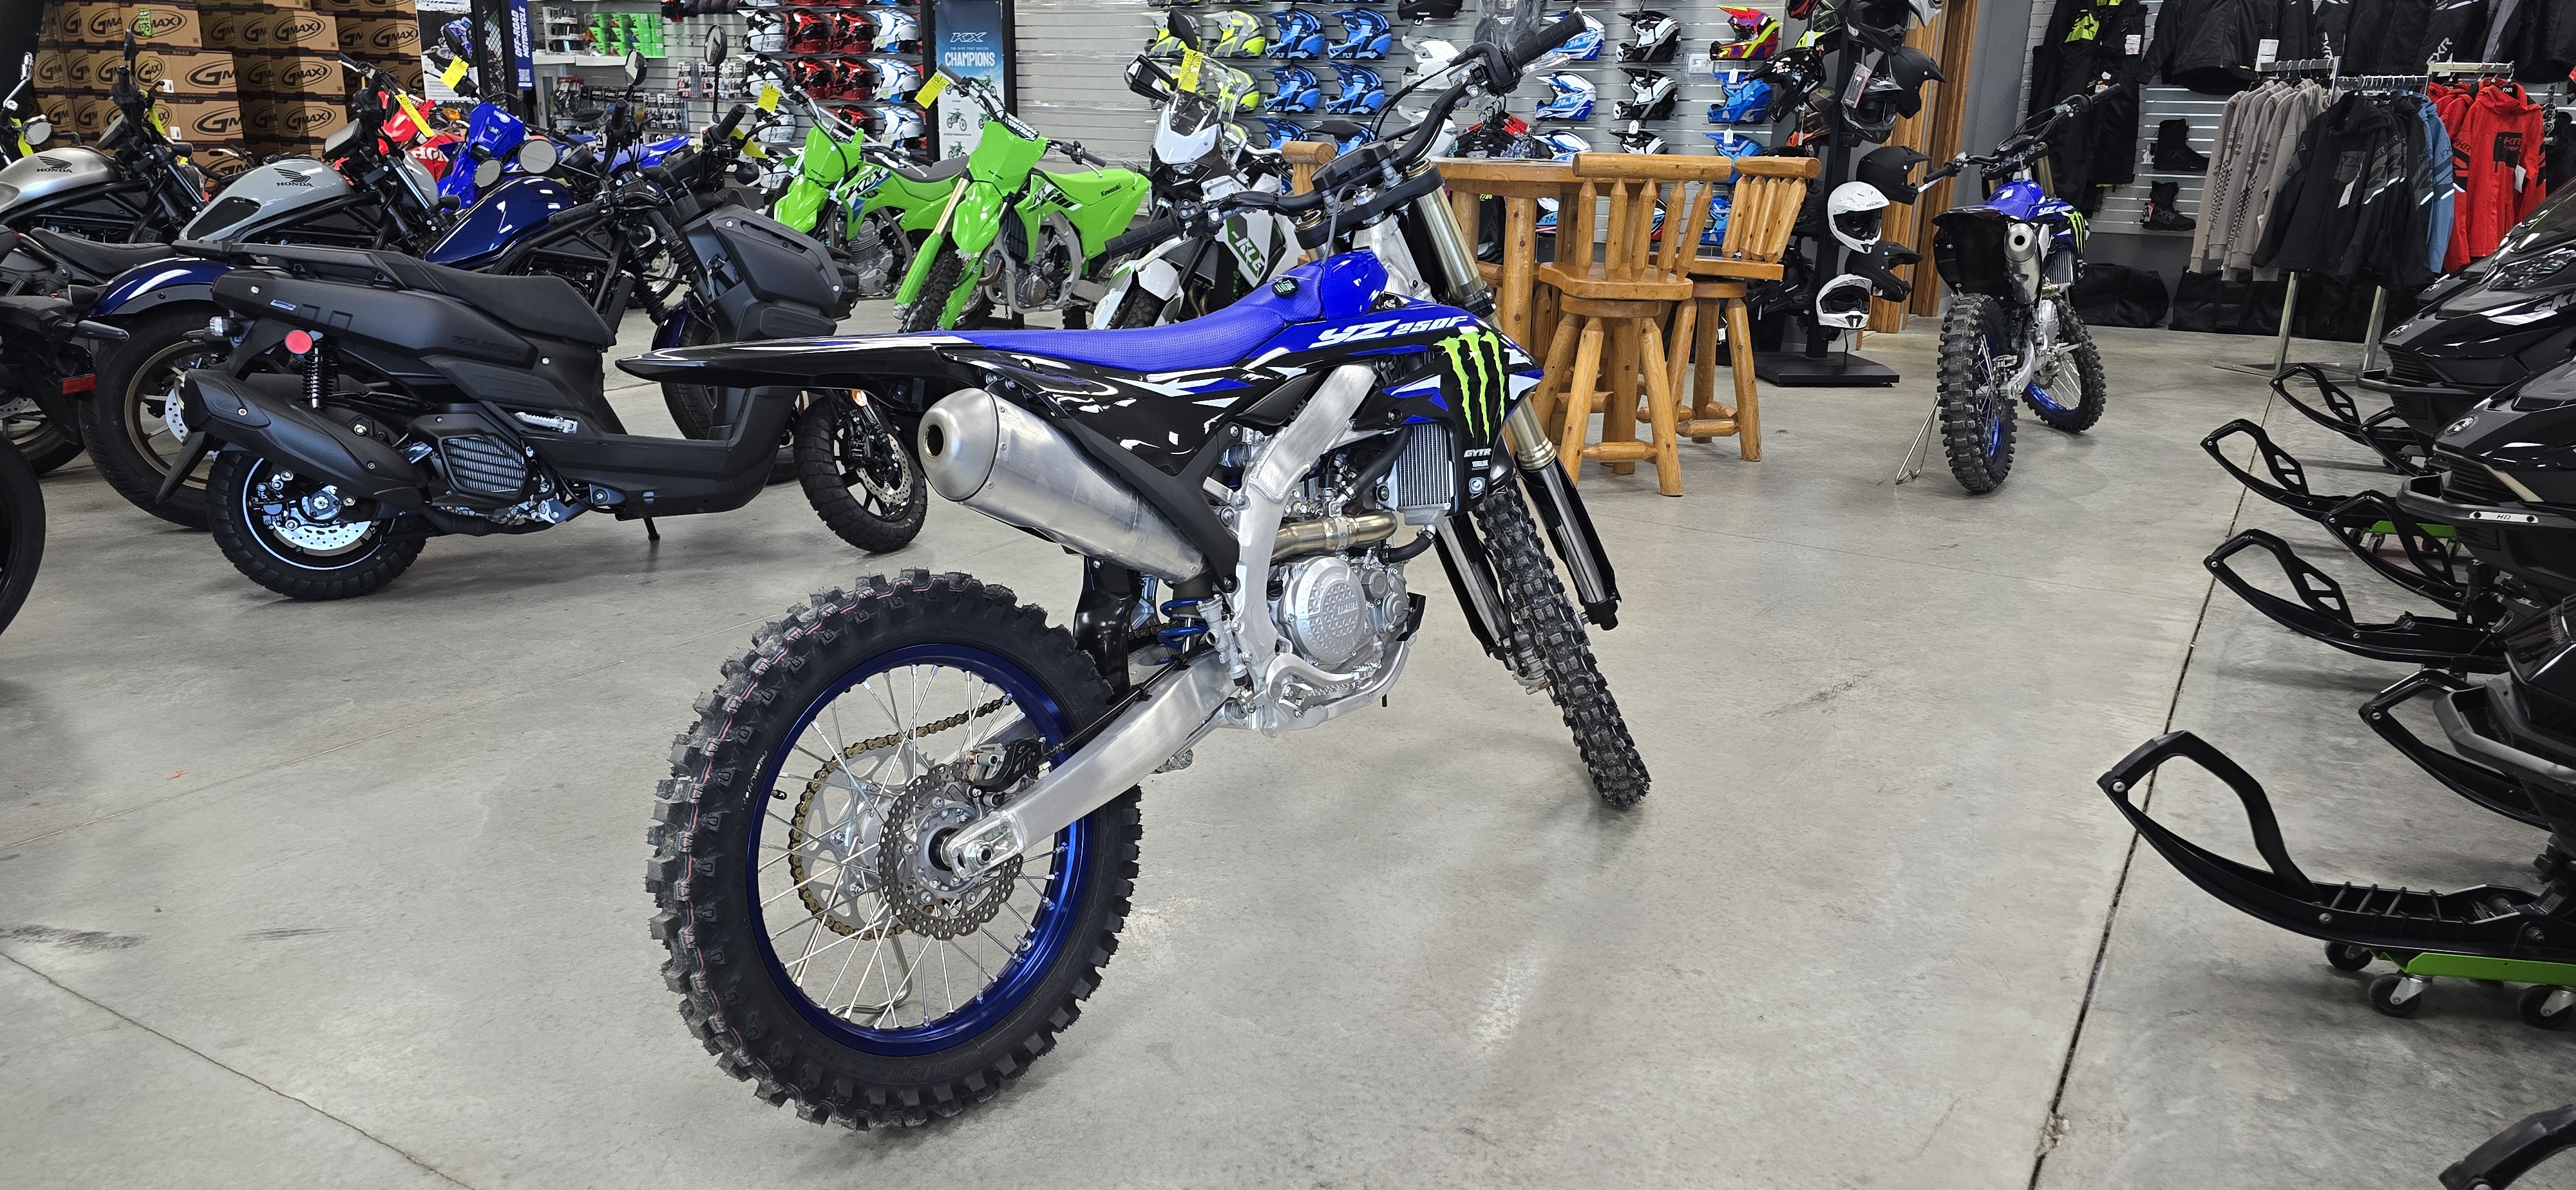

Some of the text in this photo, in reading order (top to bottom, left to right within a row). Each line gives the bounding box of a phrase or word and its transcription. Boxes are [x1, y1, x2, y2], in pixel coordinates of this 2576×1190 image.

[90, 12, 122, 34] GMA
[274, 21, 318, 41] GMAX
[518, 6, 530, 58] MOTORCYCLE
[372, 30, 417, 47] GMAX
[511, 10, 523, 57] OFF-ROAD
[950, 32, 987, 42] KX
[945, 52, 996, 67] CHAMPIONS
[190, 63, 240, 86] GM
[281, 66, 325, 86] GMAX
[1557, 93, 1584, 108] HJC
[197, 111, 243, 133] GM
[286, 111, 329, 131] GMAX
[410, 147, 450, 162] HON
[844, 167, 884, 200] KLX
[1101, 183, 1121, 197] Kawasaki
[2037, 205, 2058, 216] YZ
[1308, 316, 1468, 348] YZ 250F
[1463, 448, 1492, 458] GYTR
[1337, 601, 1359, 616] YAMAHA
